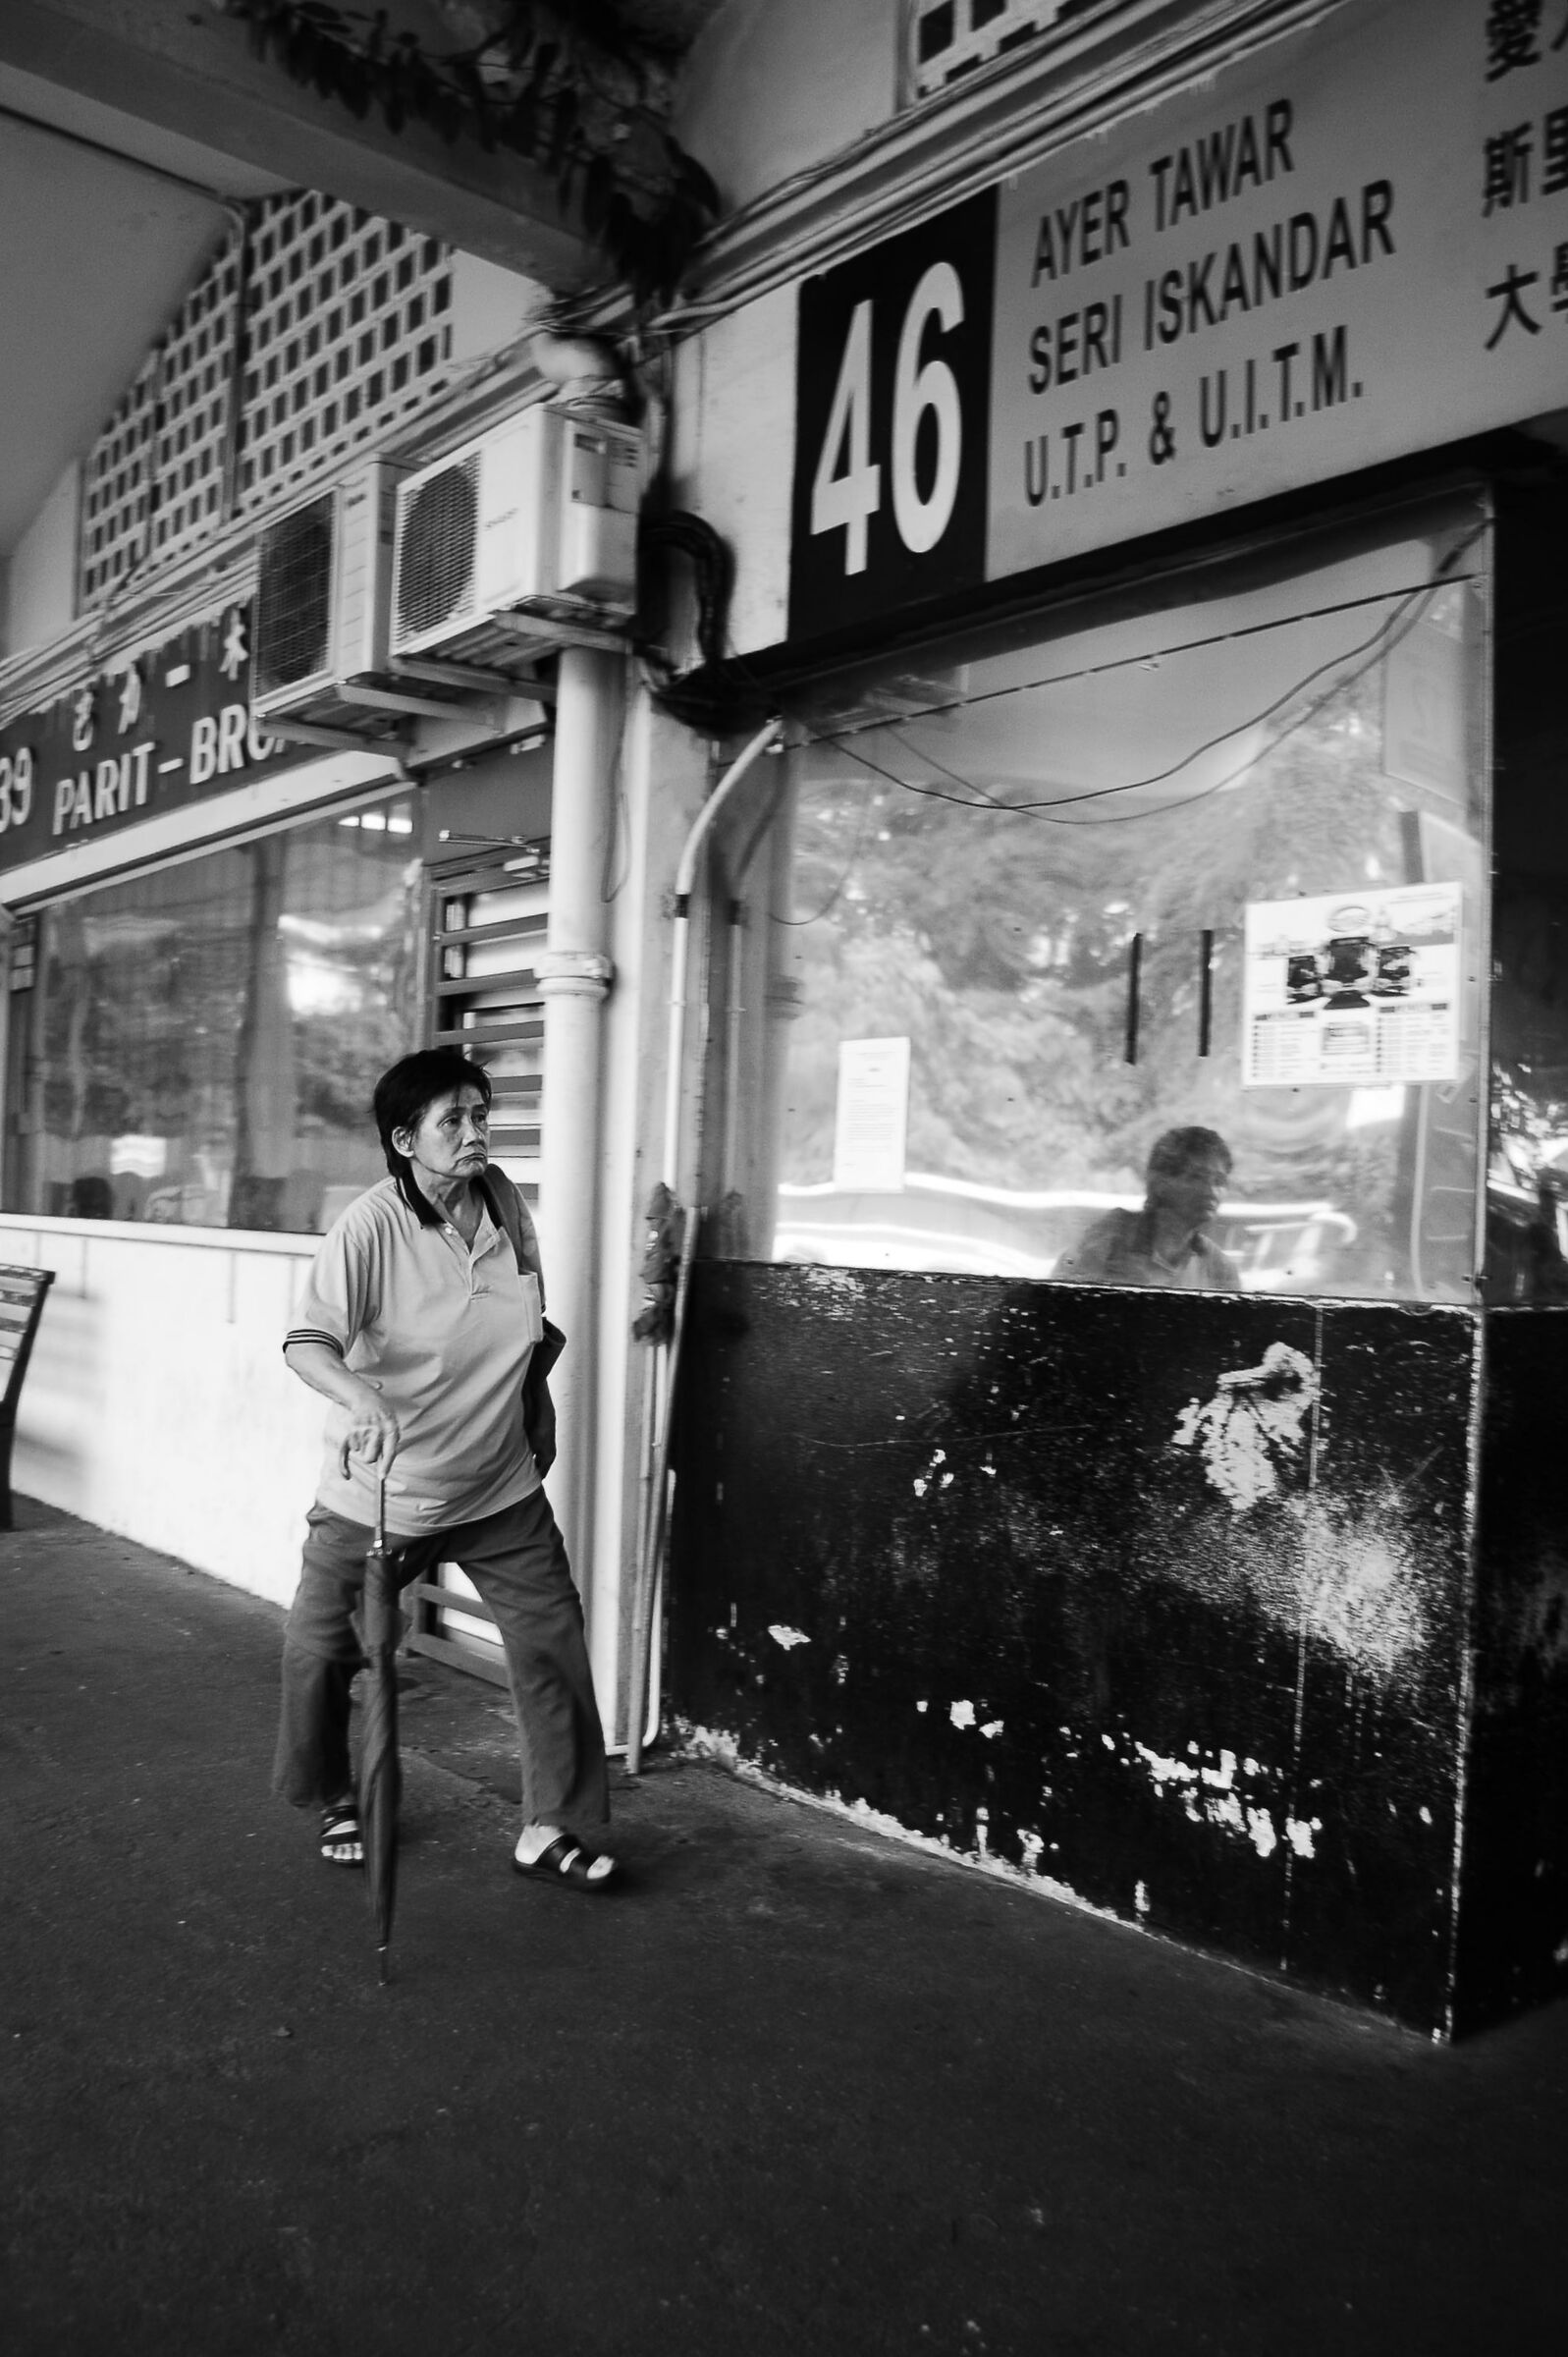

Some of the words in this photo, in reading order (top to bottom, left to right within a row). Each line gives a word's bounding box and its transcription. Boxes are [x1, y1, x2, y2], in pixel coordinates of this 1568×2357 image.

[1028, 295, 1122, 395] SERI
[1144, 179, 1396, 352] ISKANDAR
[1031, 179, 1130, 289] AYER
[1149, 98, 1295, 232] TAWAR
[811, 262, 964, 576] 46
[1024, 409, 1126, 507] U.T.P.
[1149, 391, 1176, 466] &
[1200, 324, 1364, 448] U.I.T.M.
